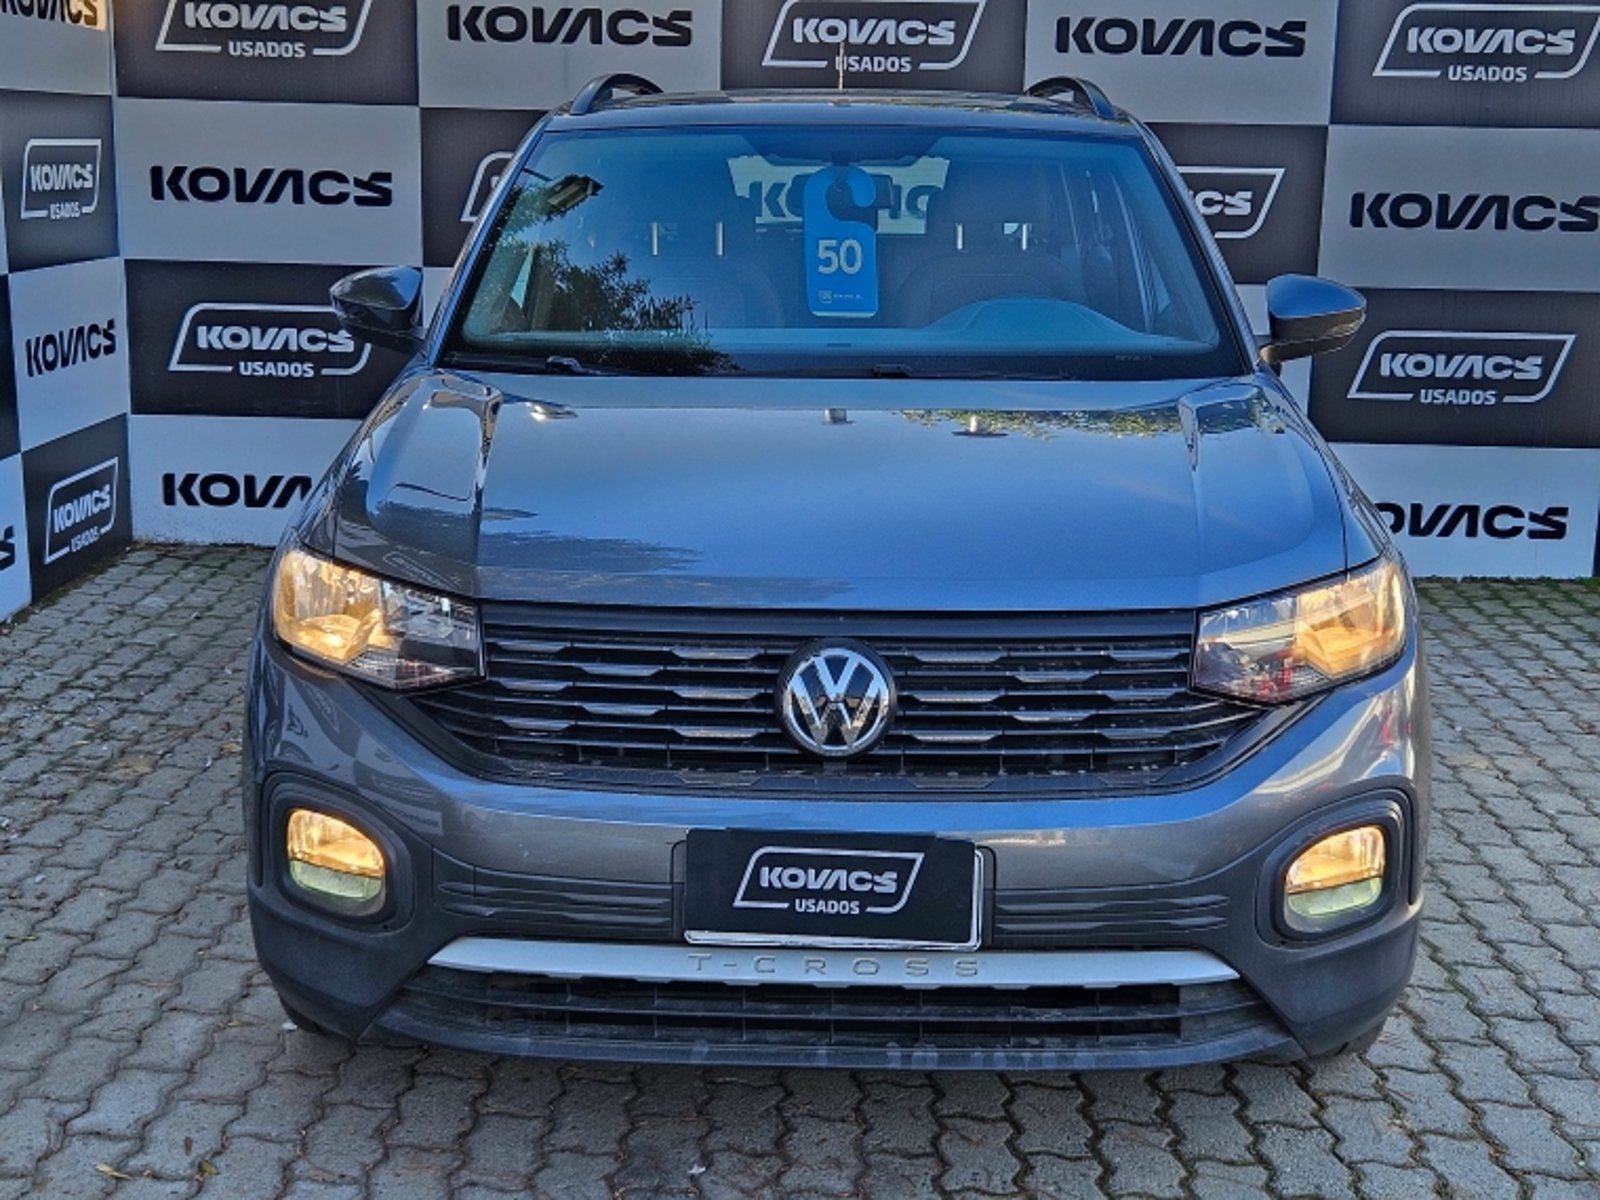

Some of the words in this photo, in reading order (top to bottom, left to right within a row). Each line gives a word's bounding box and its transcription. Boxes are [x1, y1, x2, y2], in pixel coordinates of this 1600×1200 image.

[184, 1, 347, 32] KOVACS
[447, 4, 693, 46] KOVACS
[793, 17, 956, 45] KOVACS
[1055, 16, 1307, 57] KOVACS
[1407, 27, 1576, 55] KOVACS
[228, 41, 306, 58] USADOS
[1448, 65, 1527, 82] USADOS
[30, 164, 93, 192] KOVACS
[150, 165, 393, 207] KOVACS
[1349, 191, 1600, 233] KOVACS
[817, 239, 863, 274] 50
[25, 318, 116, 378] KOVACS
[197, 325, 354, 352] KOVACS
[239, 361, 315, 378] USADOS
[1380, 353, 1543, 380] KOVACS
[1420, 388, 1497, 405] USADOS
[162, 472, 312, 508] KOVA
[53, 484, 111, 533] KOVACS
[759, 866, 898, 894] KOVACS
[795, 898, 860, 915] USADOS
[688, 953, 979, 977] T-CROSS
